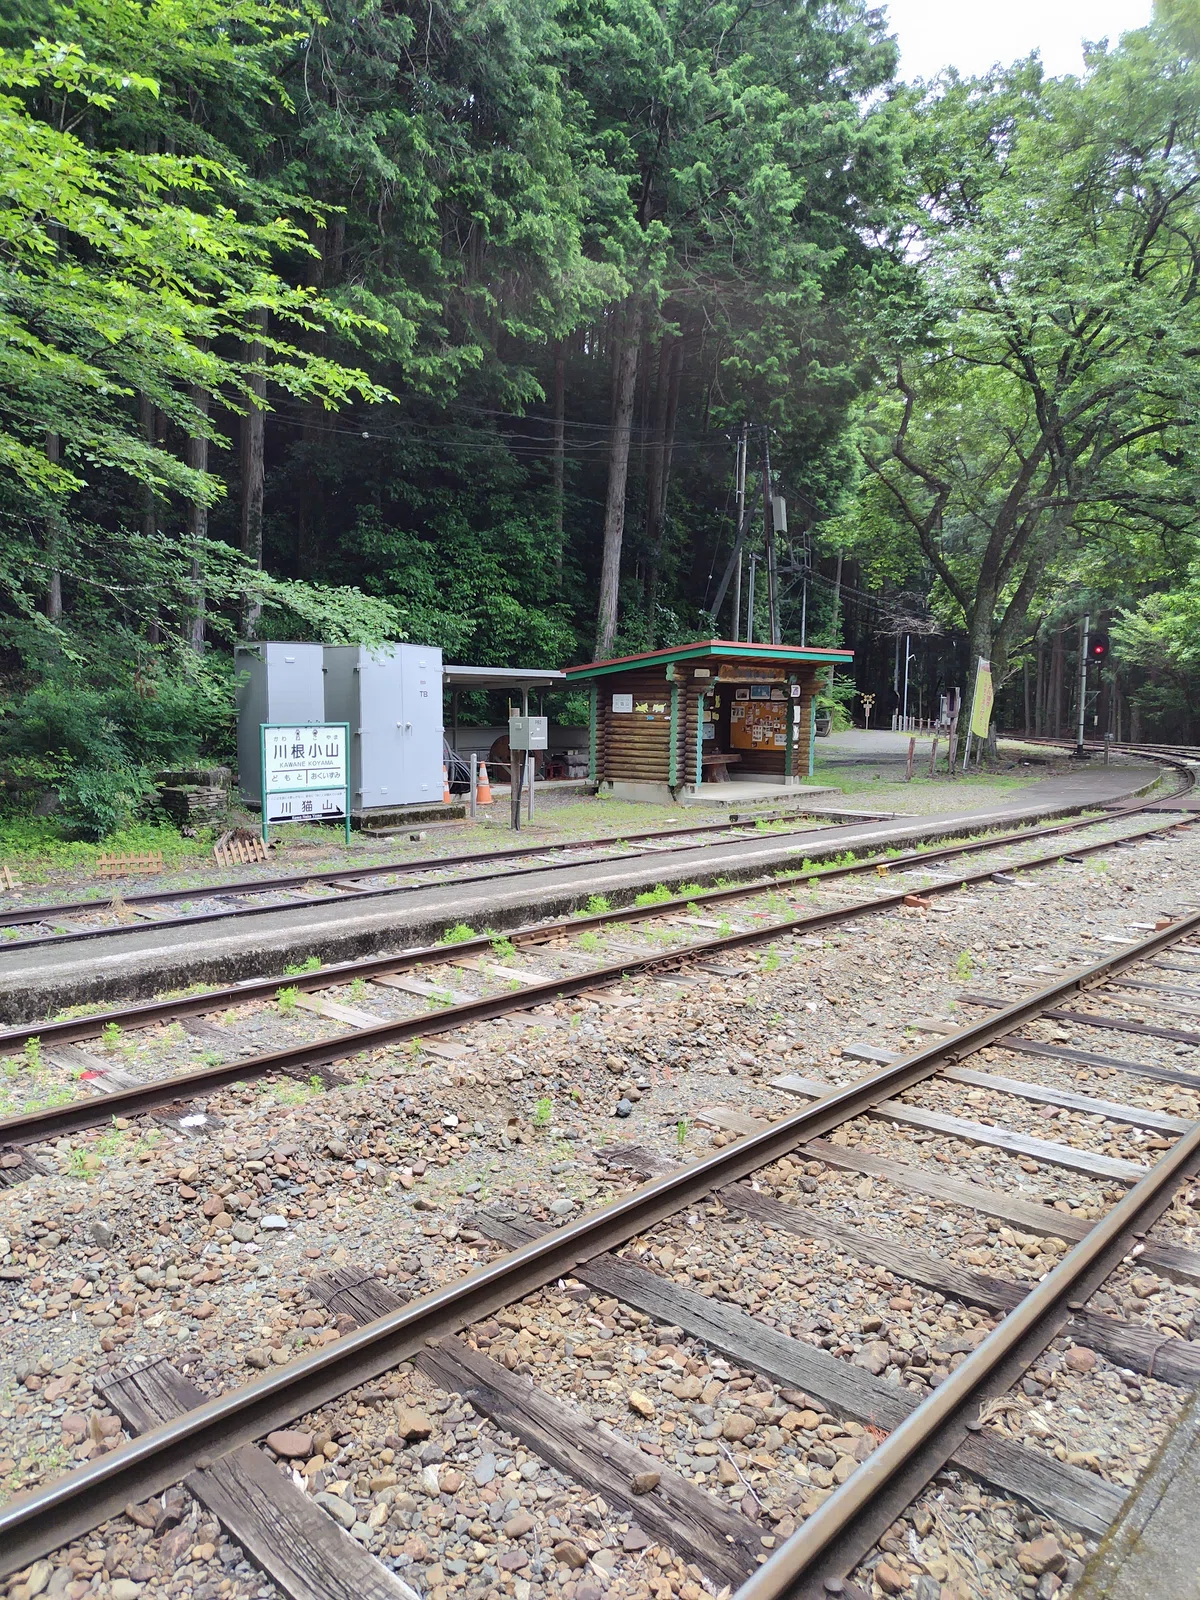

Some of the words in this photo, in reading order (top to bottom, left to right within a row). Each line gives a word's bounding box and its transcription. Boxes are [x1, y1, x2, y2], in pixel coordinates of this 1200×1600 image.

[419, 690, 428, 698] TB
[274, 743, 338, 759] 川根小山
[279, 761, 306, 769] KAWANE
[280, 799, 333, 814] 川猫山
